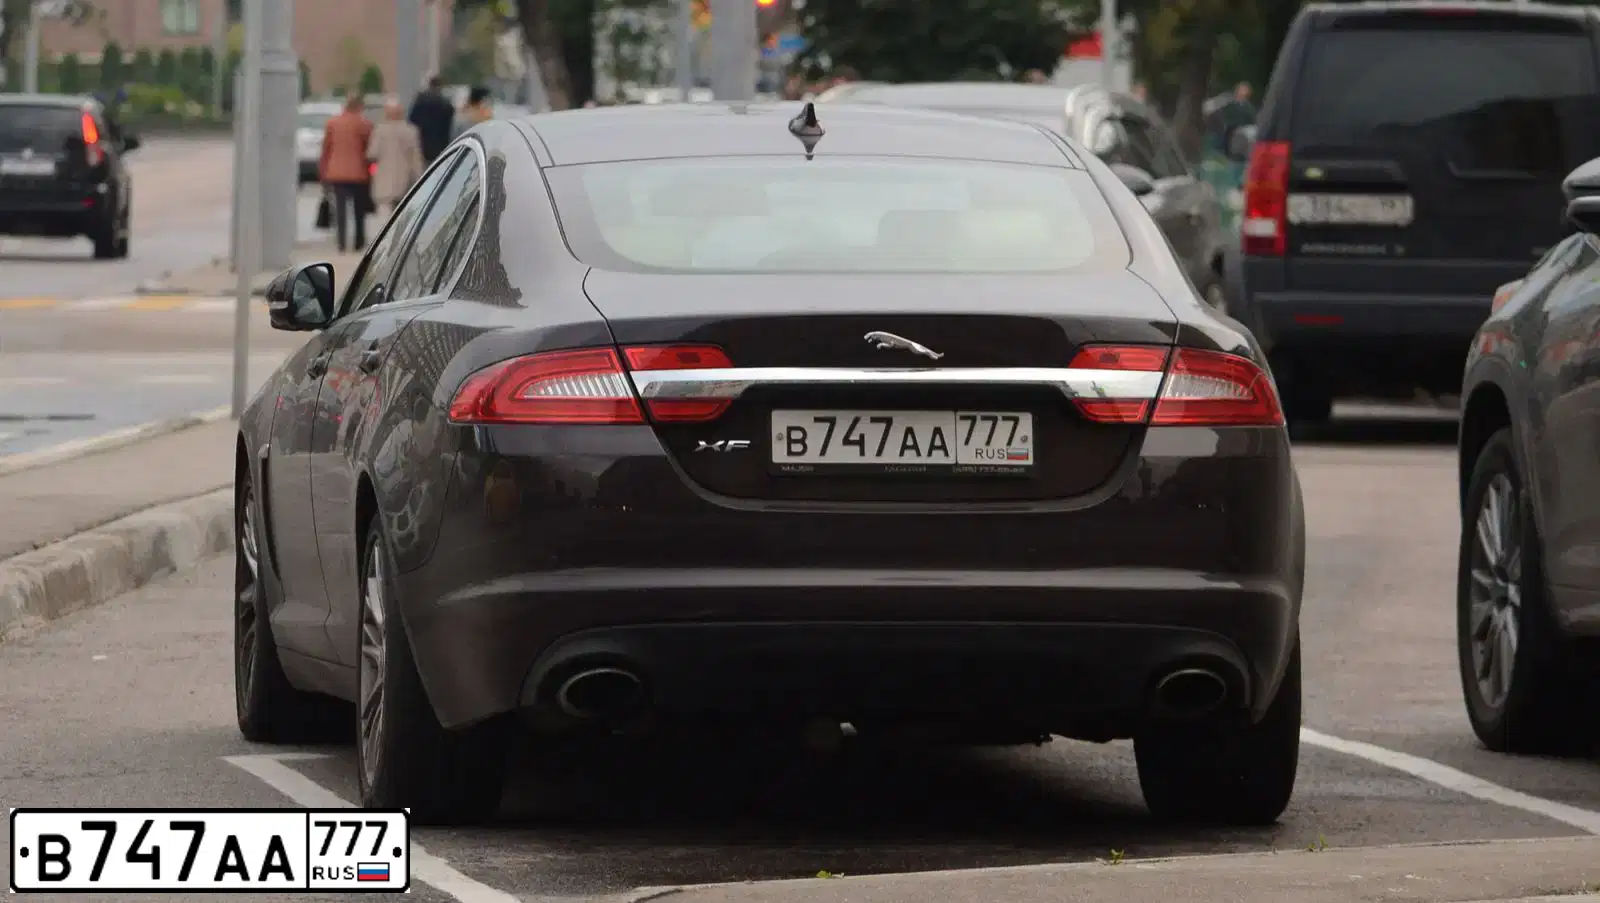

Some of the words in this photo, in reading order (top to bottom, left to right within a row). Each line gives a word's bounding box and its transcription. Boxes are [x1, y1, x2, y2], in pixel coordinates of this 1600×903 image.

[959, 415, 1021, 446] 777
[694, 440, 750, 452] XF
[975, 448, 1005, 460] RUS
